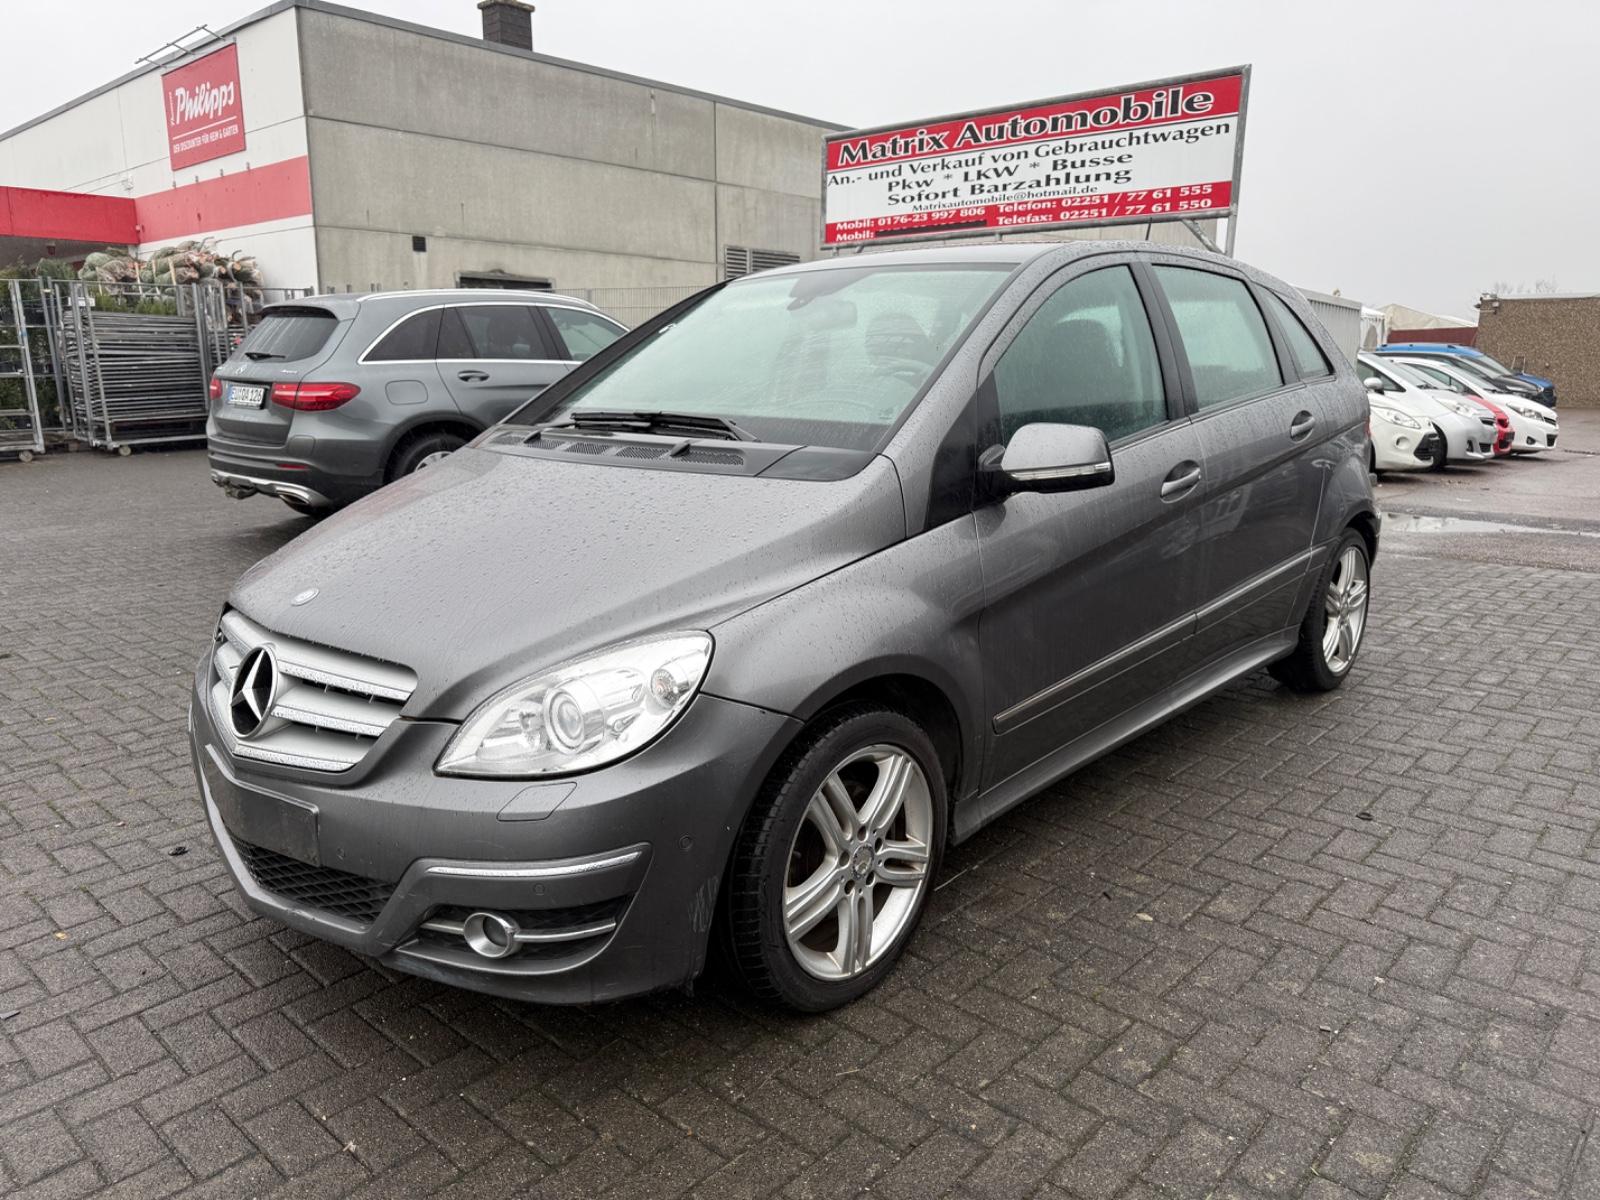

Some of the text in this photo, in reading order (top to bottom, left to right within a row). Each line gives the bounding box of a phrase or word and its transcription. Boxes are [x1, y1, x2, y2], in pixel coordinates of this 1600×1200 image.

[175, 81, 235, 125] Philipps
[837, 86, 1215, 167] Matrix Automobile
[827, 122, 1230, 187] An.- und Verkauf von Gebrauchtwagen
[887, 168, 1133, 206] Sofort Barzahlung
[888, 178, 935, 193] Pkw
[963, 164, 1020, 183] LKW
[1052, 152, 1133, 172] Busse
[912, 185, 1098, 212] Matrixautomobile@hotmail.de
[996, 198, 1212, 226] Telefax: 02251 / 77 61 550
[997, 184, 1213, 213] Telefon: 02251 / 77 61 555
[835, 219, 875, 231] Mobil:
[877, 212, 929, 227] 0176-23
[931, 208, 956, 221] 997
[959, 206, 986, 218] 806
[835, 230, 875, 242] Mobil:
